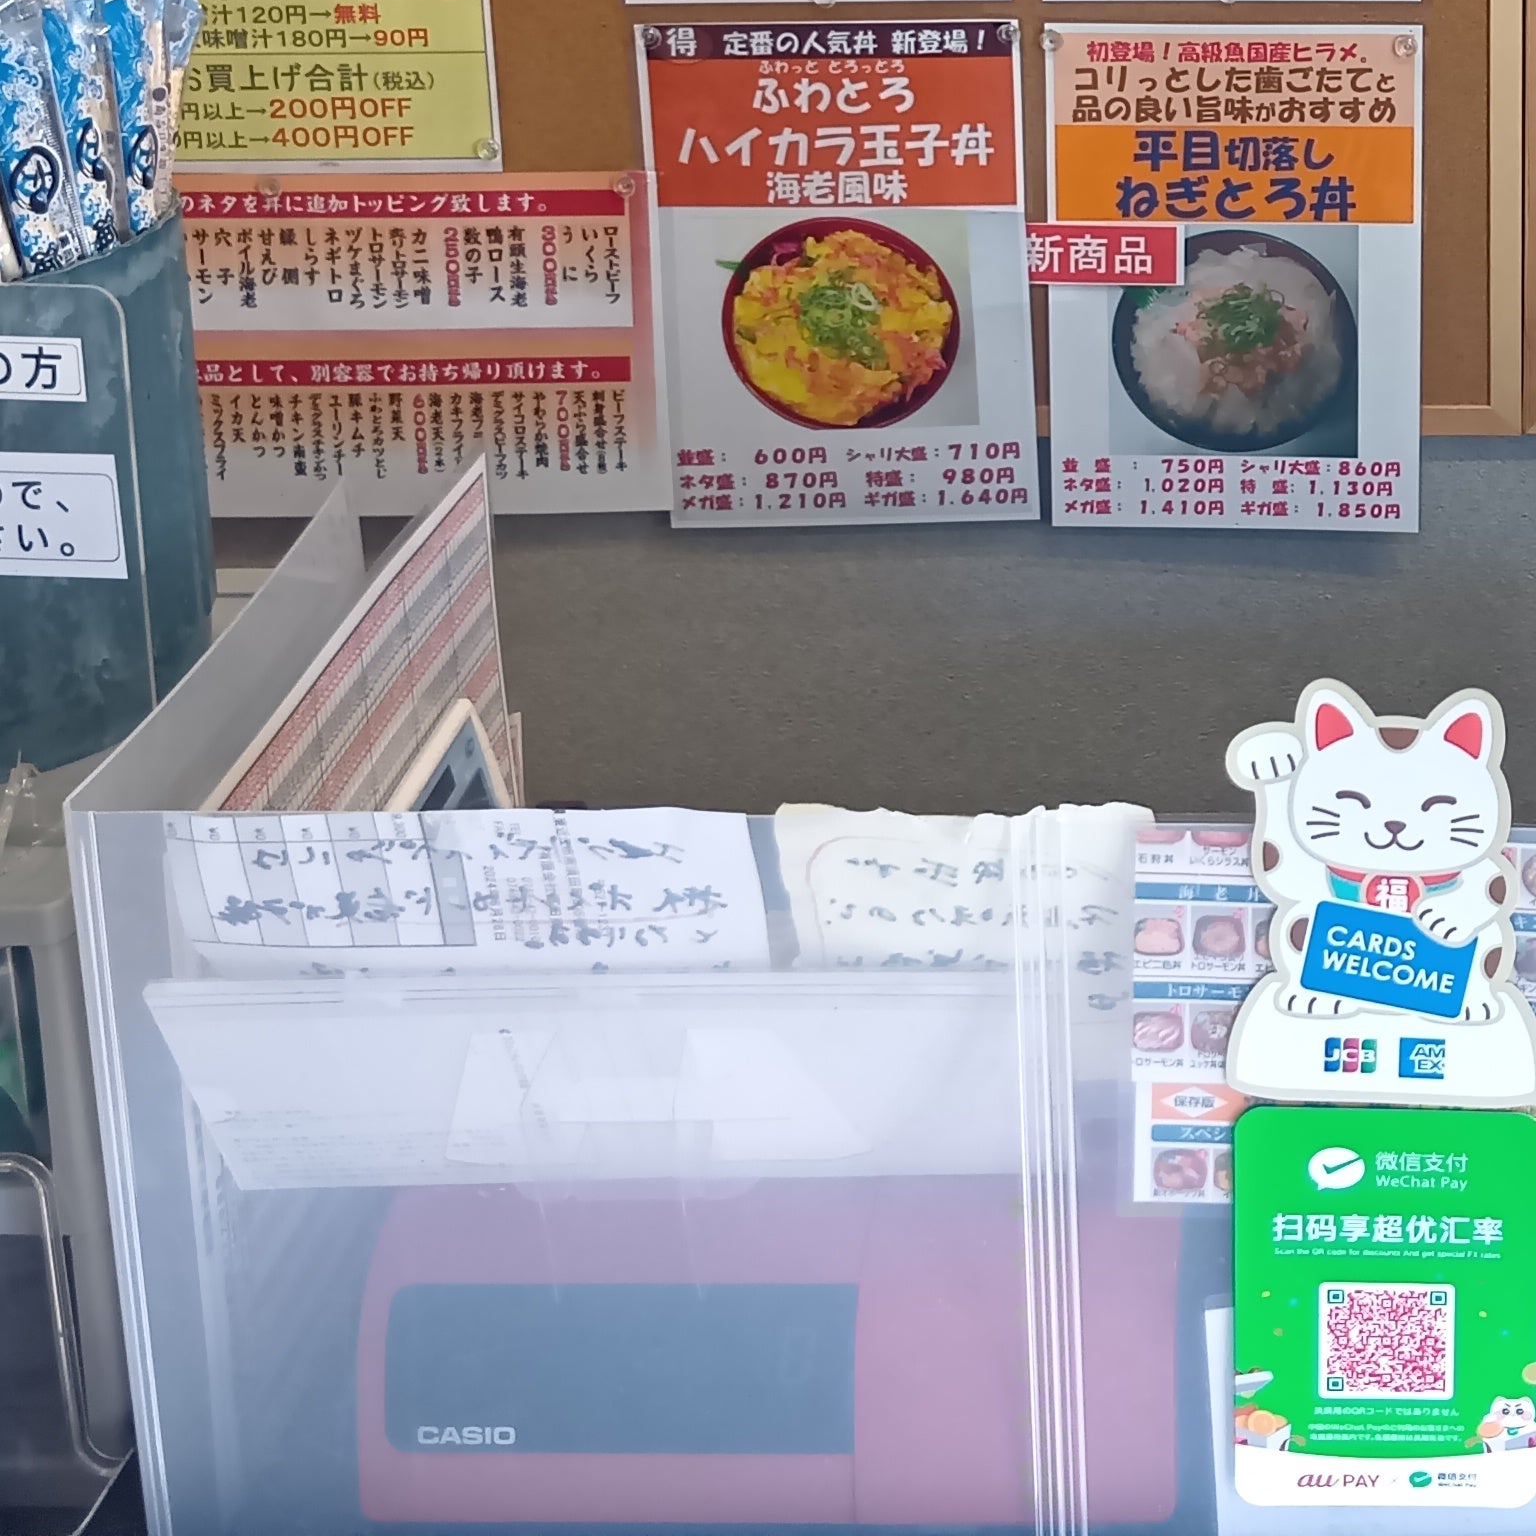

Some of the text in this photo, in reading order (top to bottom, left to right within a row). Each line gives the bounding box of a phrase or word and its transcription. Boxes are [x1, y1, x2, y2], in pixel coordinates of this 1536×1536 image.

[334, 4, 381, 24] 無料
[666, 29, 697, 57] 得
[723, 31, 878, 55] 定番の人気丼
[270, 96, 412, 120] 200円OFF
[753, 76, 915, 114] ふわとろ
[1072, 96, 1396, 124] 品の良い旨味がおすすめ
[272, 125, 414, 148] 400円OFF
[678, 123, 995, 168] ハイカラ玉子丼
[1133, 130, 1335, 172] 平目切落し
[766, 171, 909, 205] 海老風味
[1116, 175, 1357, 222] ねぎとろ丼
[1027, 234, 1153, 275] 新商品
[197, 362, 610, 382] 品として、別容器でお持ち帰り頂けます。
[1375, 877, 1410, 913] 福
[1326, 925, 1417, 961] CARDS
[1322, 949, 1456, 994] WELCOME
[1325, 1047, 1377, 1064] JCB
[1375, 1151, 1469, 1173] 微信支付
[1375, 1175, 1468, 1191] WeChat Pay
[1272, 1213, 1504, 1245] 扫码享超优汇率
[416, 1425, 516, 1446] CASIO
[1343, 1474, 1380, 1487] PAY
